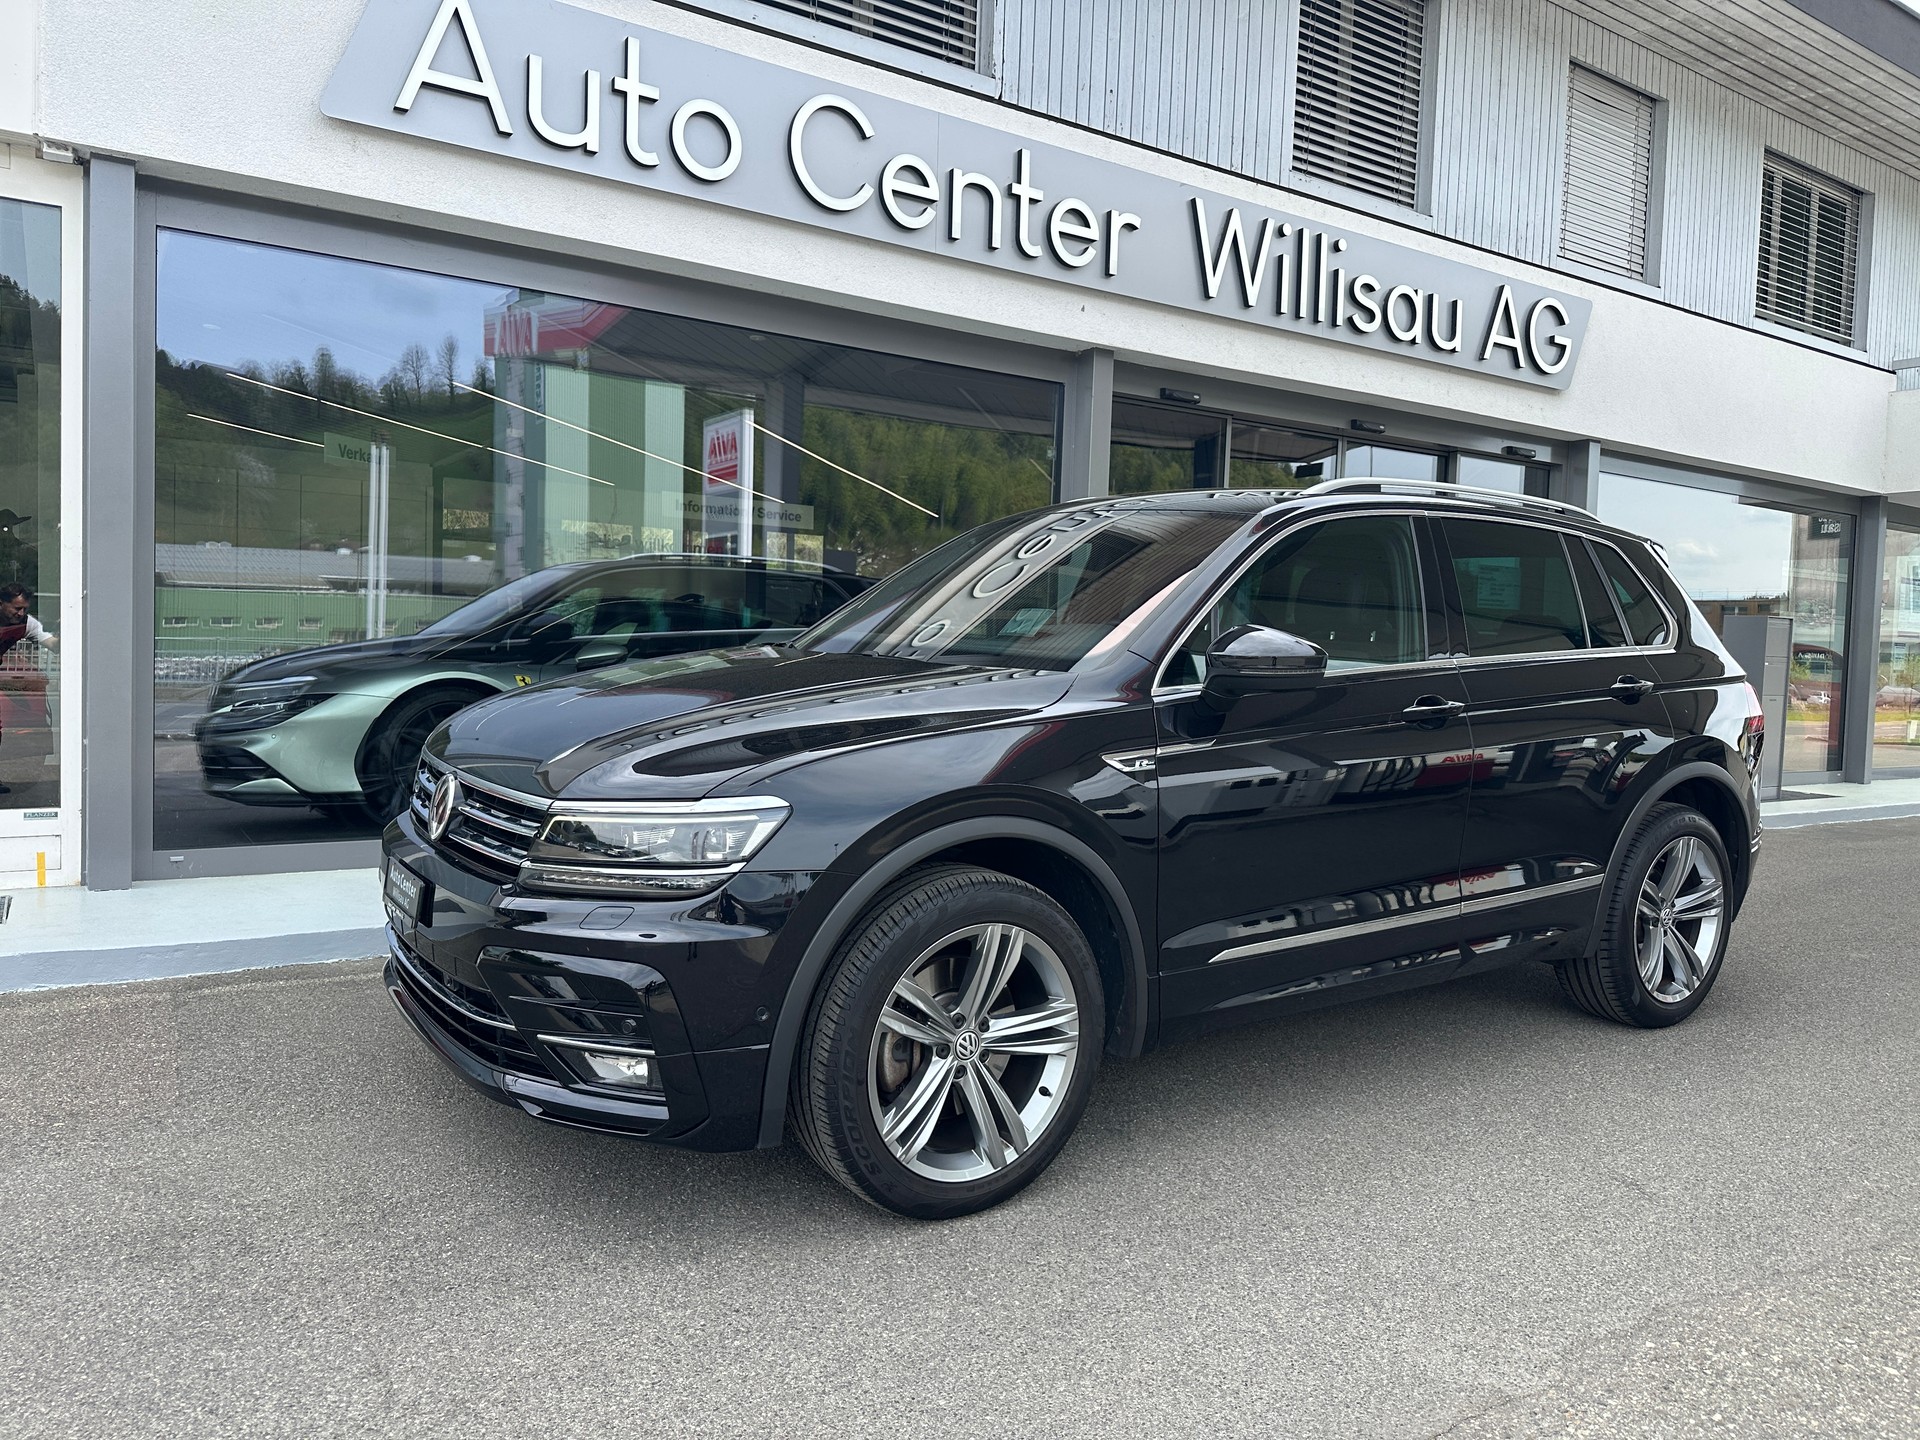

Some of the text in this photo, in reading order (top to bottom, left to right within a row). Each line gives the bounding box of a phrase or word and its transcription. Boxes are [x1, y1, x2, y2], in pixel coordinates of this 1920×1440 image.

[393, 0, 1573, 375] Auto Center Willisau AG
[338, 443, 375, 463] Verka
[676, 498, 743, 517] Informatio
[757, 507, 802, 522] Service
